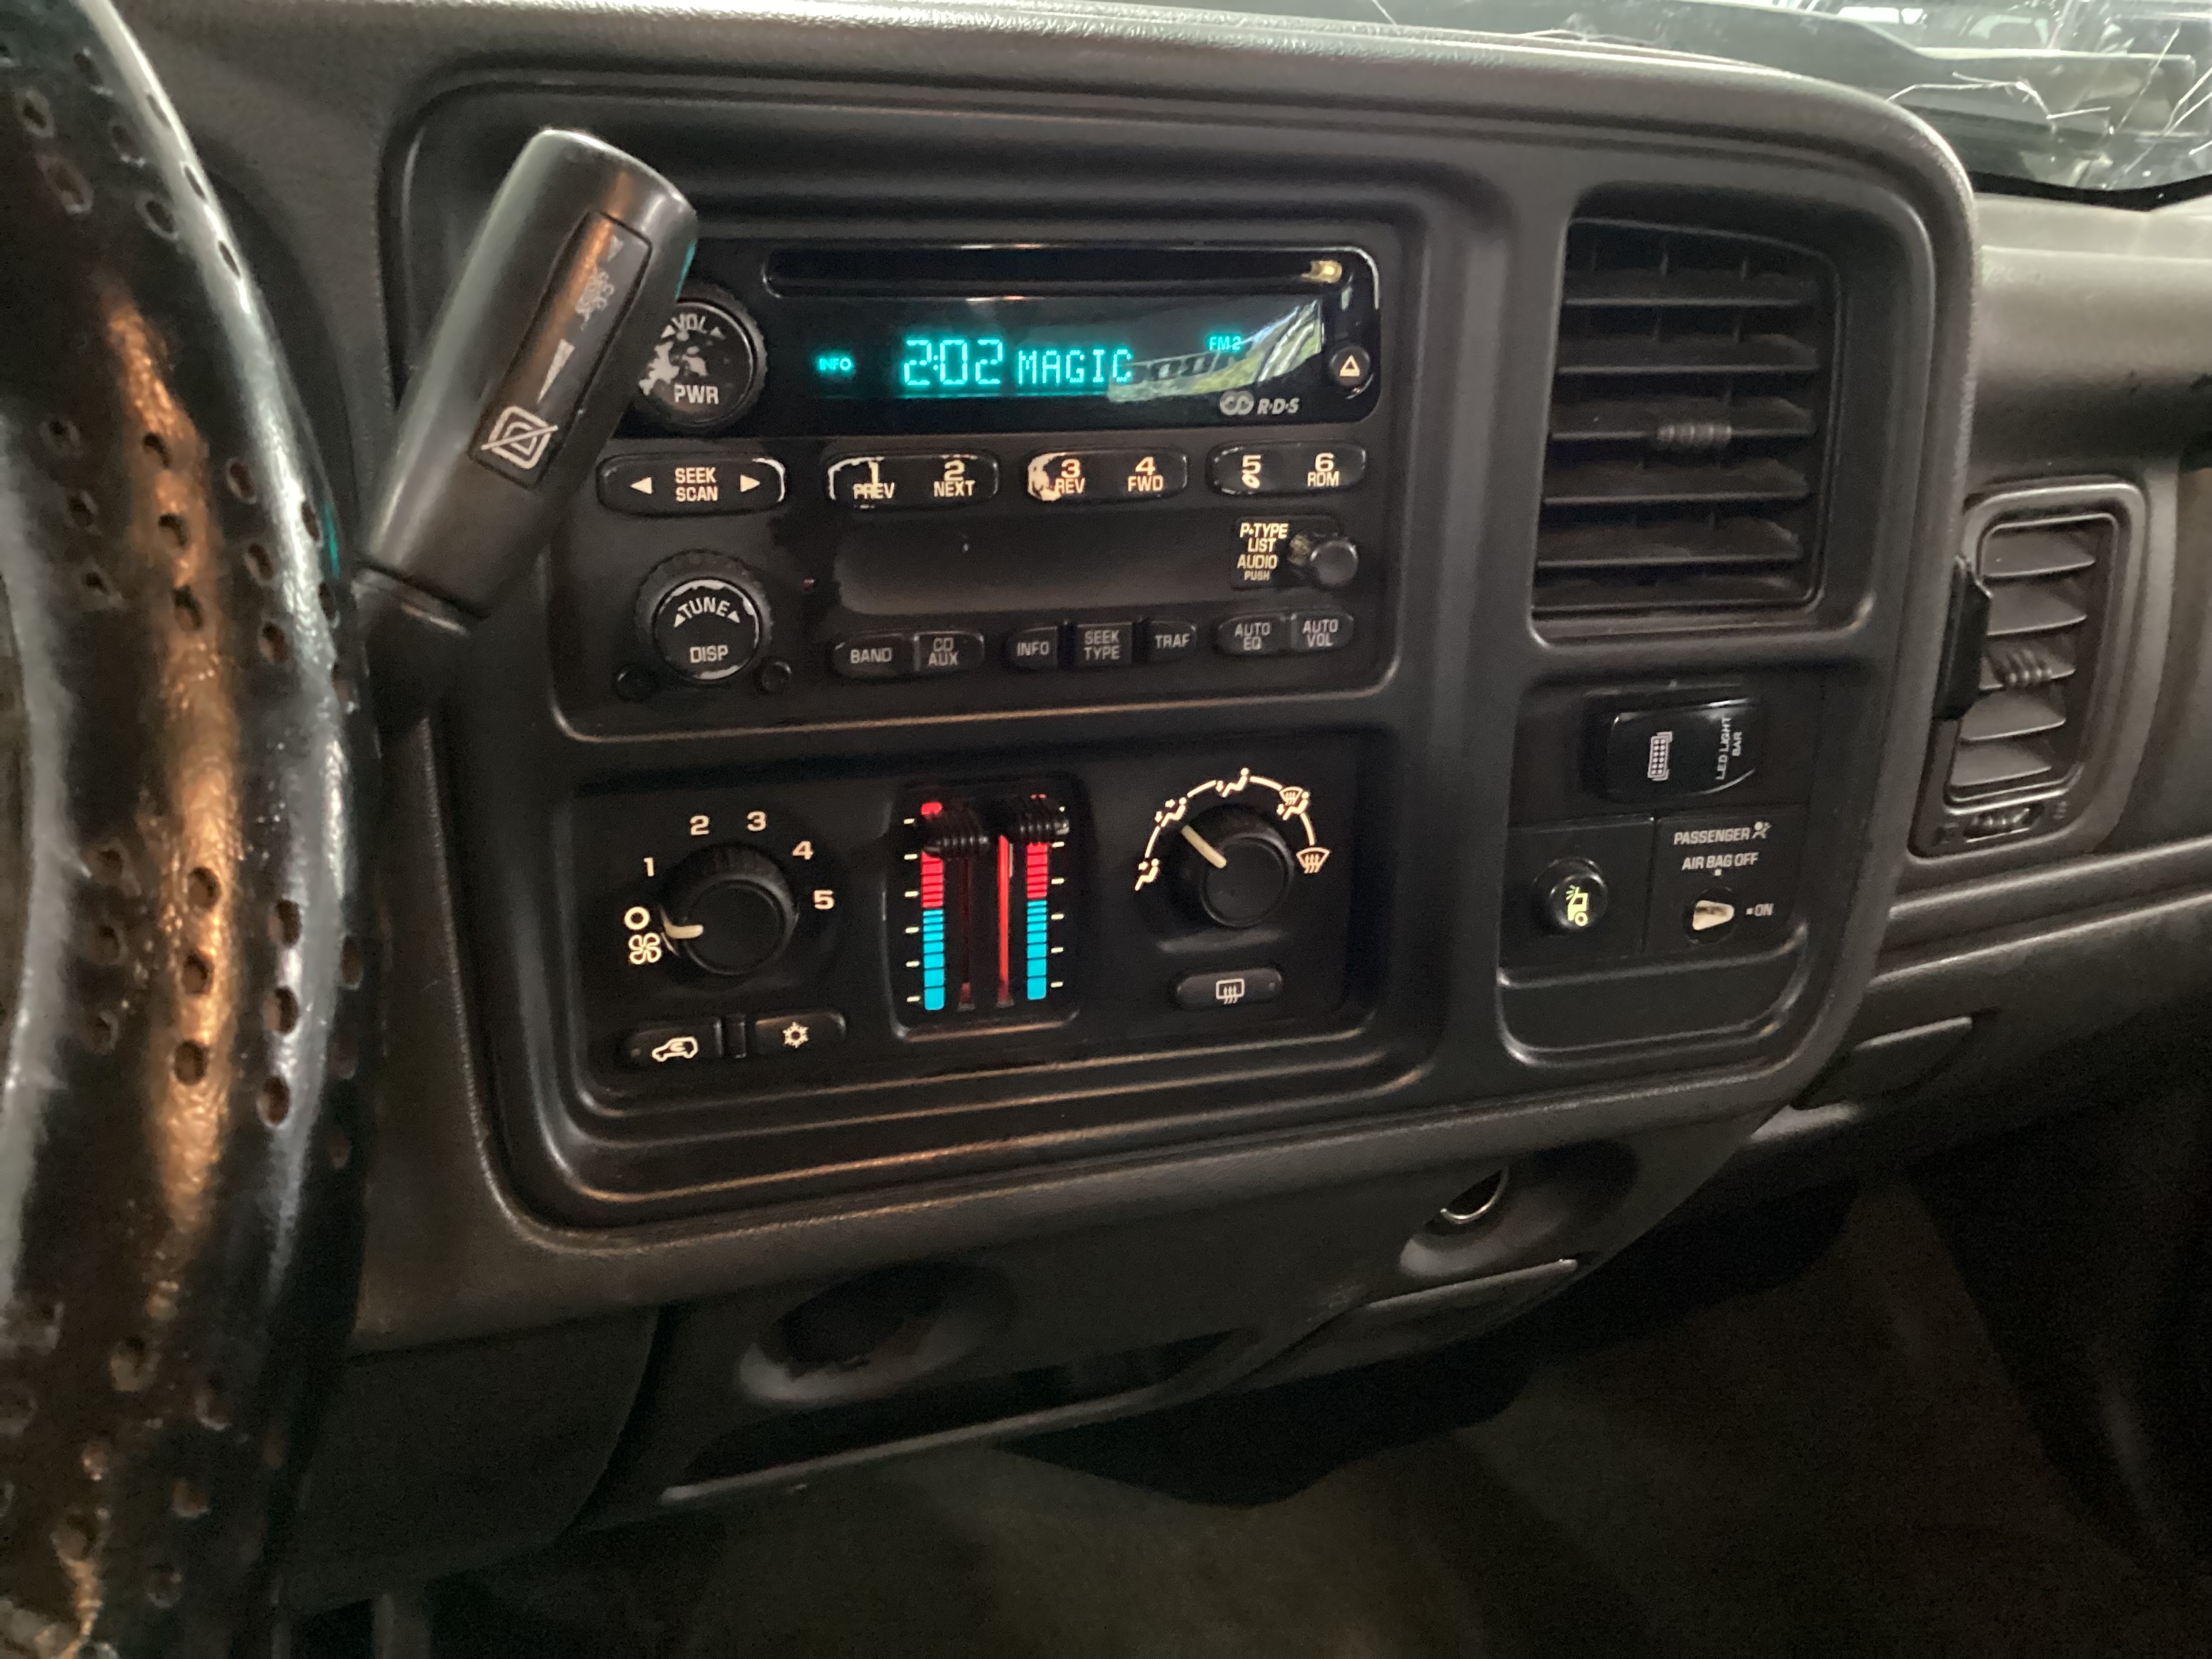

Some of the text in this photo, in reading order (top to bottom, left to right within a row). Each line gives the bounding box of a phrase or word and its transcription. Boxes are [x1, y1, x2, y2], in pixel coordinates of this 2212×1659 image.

[671, 313, 708, 334] VOL
[1210, 336, 1242, 351] FM2
[819, 357, 852, 371] INFO
[903, 339, 1132, 386] 2:02 MAGIC
[674, 383, 720, 405] PWR
[944, 459, 965, 481] 2
[1061, 459, 1081, 478] 3
[1135, 456, 1156, 474] 4
[1242, 454, 1262, 474] 5
[1315, 452, 1334, 472] 6
[674, 467, 716, 483] SEEK
[868, 460, 880, 483] 1
[1307, 471, 1340, 487] RDM
[853, 482, 895, 499] PREV
[933, 480, 976, 497] NEXT
[1054, 478, 1084, 495] REV
[1128, 475, 1164, 492] FWD
[676, 487, 718, 502] SCAN
[1247, 538, 1276, 552] LIST
[1237, 554, 1277, 569] AUDIO
[1244, 571, 1270, 581] PUSH
[678, 596, 732, 618] TUNE
[1234, 621, 1271, 637] AUTO
[1302, 618, 1338, 634] AUTO
[933, 637, 954, 653] CD
[1084, 629, 1120, 644] SEEK
[1154, 632, 1191, 649] TRAF
[1243, 636, 1262, 651] EQ
[1307, 632, 1333, 648] VOL
[689, 644, 729, 663] DISP
[850, 647, 893, 663] BAND
[1017, 641, 1050, 657] INFO
[1084, 644, 1120, 661] TYPE
[928, 651, 959, 667] AUX
[1715, 716, 1732, 781] LED LIGHT
[1732, 731, 1742, 757] BAR
[689, 815, 710, 836] 2
[747, 811, 767, 832] 3
[1673, 827, 1750, 846] PASSENGER
[792, 840, 814, 860] 4
[643, 857, 655, 877] 1
[1681, 852, 1759, 871] AIR BAG OFF
[813, 889, 835, 909] 5
[1754, 903, 1774, 916] ON
